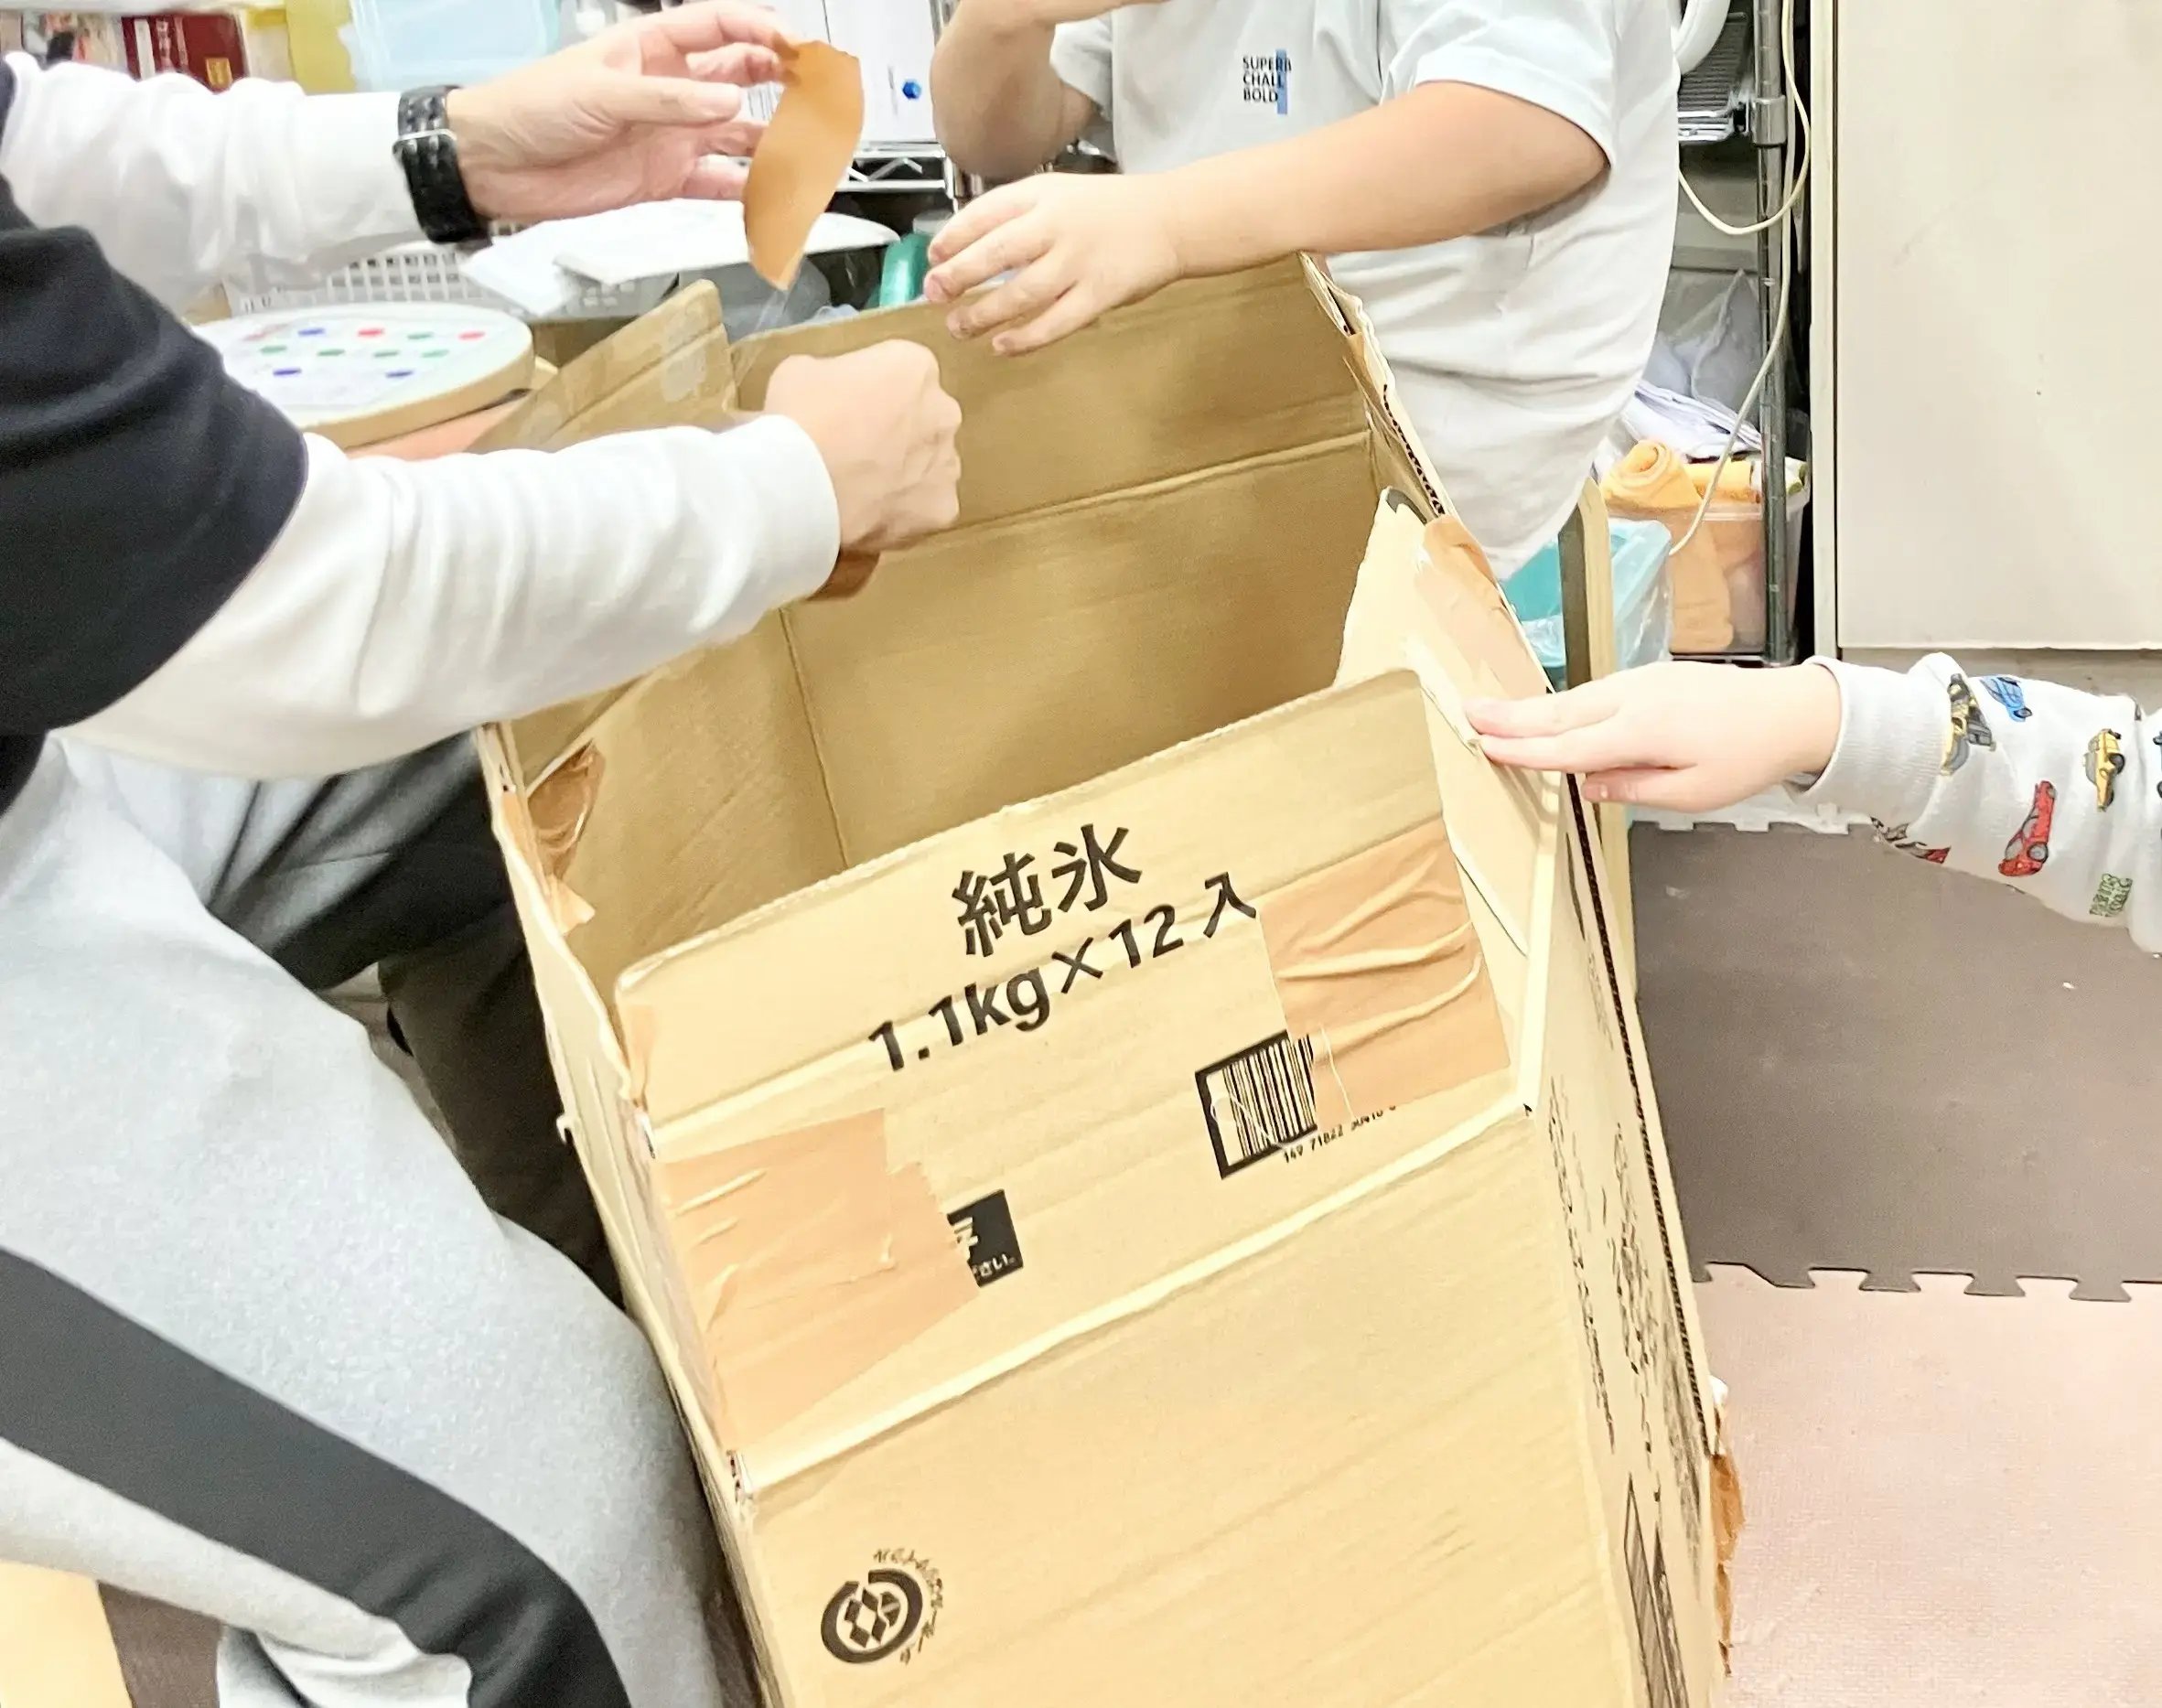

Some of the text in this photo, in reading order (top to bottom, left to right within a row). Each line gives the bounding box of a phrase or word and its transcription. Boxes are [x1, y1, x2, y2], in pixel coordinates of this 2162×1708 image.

[1242, 70, 1285, 89] CHALL
[1243, 87, 1279, 102] BOLD
[951, 823, 1143, 957] 純氷
